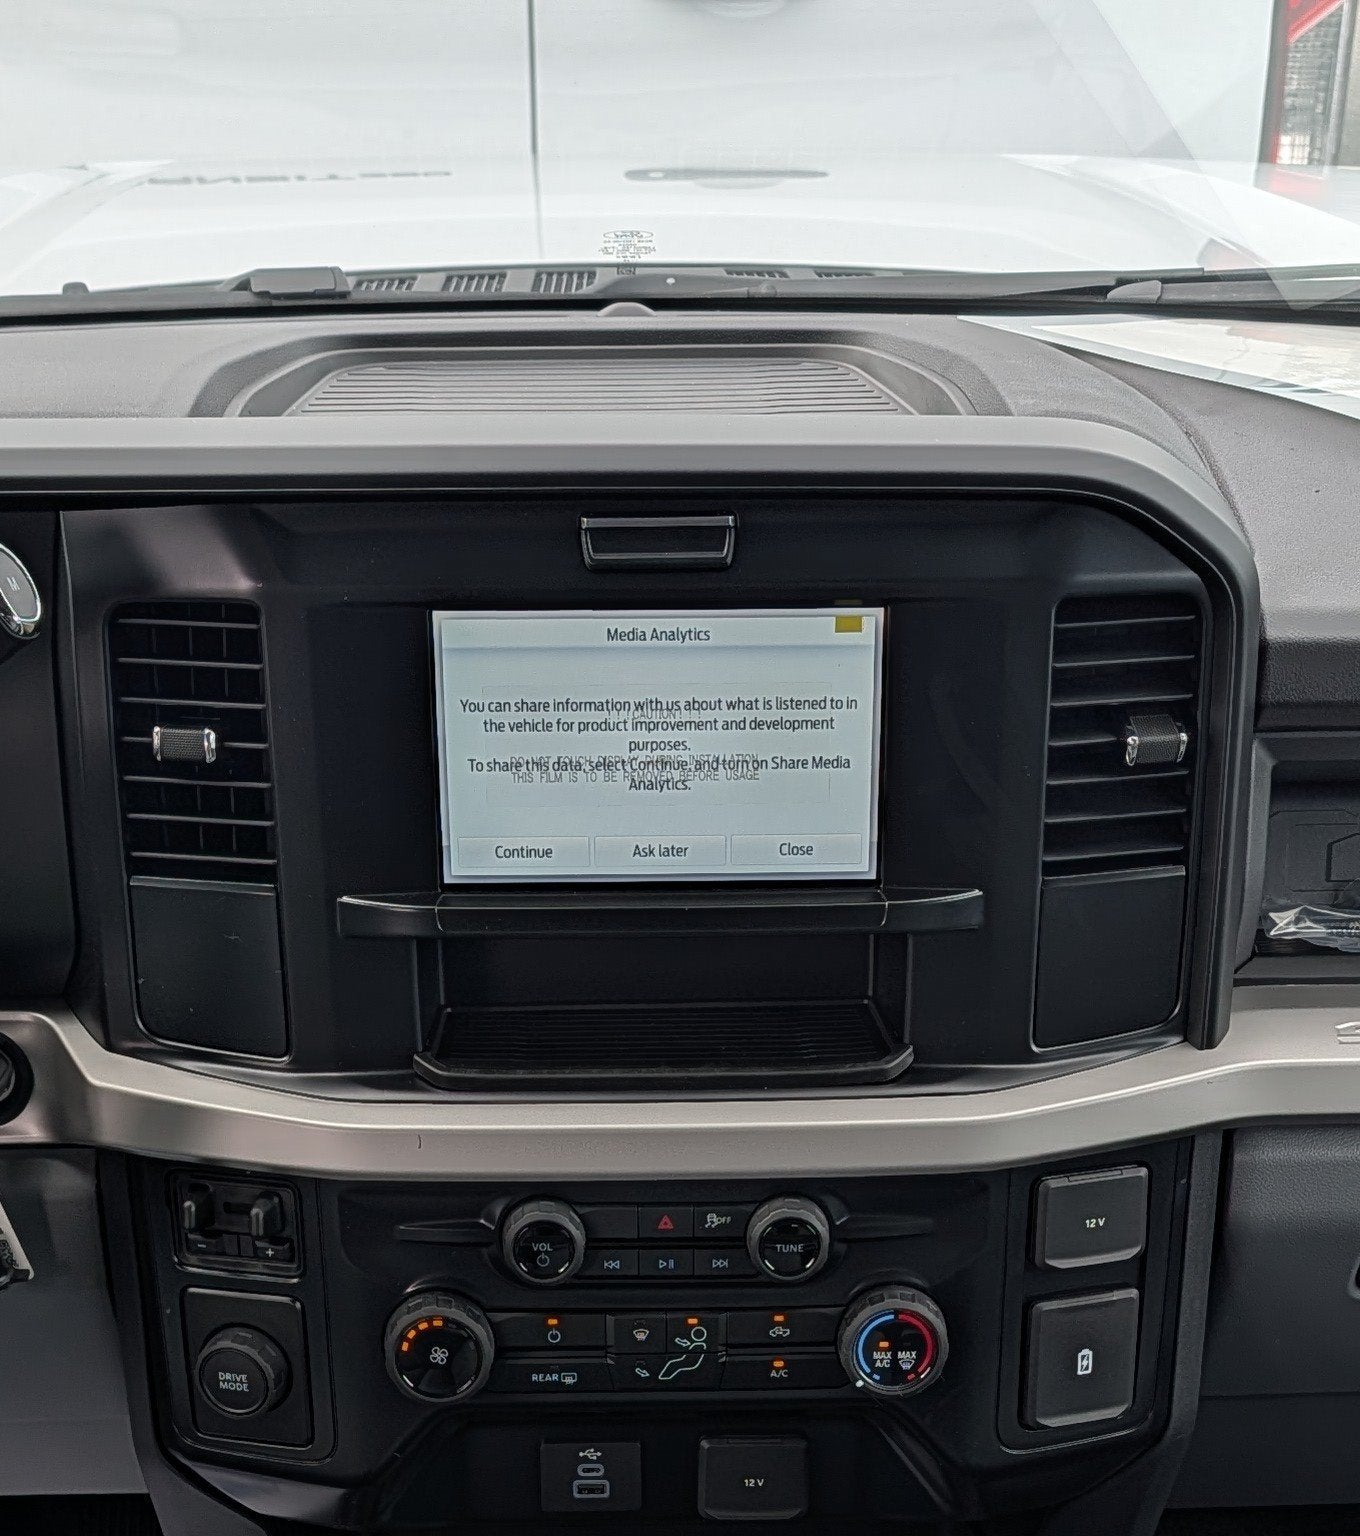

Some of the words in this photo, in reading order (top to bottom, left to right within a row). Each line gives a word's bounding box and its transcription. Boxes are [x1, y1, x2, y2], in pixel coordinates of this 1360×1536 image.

[606, 627, 646, 641] Media
[650, 627, 711, 643] Analytics
[460, 698, 485, 713] You
[487, 701, 511, 713] can
[513, 698, 550, 713] share
[553, 697, 631, 712] information
[633, 697, 665, 712] with
[666, 700, 681, 711] us
[683, 697, 723, 711] about
[726, 697, 760, 711] what
[763, 697, 773, 710] is
[775, 696, 827, 711] listened
[830, 697, 843, 710] to
[846, 696, 858, 710] in
[483, 718, 506, 733] the
[508, 718, 553, 733] vehicle
[556, 717, 575, 732] for
[578, 718, 629, 734] product
[631, 717, 719, 734] improvement
[722, 717, 746, 731] and
[749, 716, 835, 733] development
[628, 740, 691, 753] purposes.
[467, 758, 484, 773] To
[486, 758, 522, 773] share
[525, 757, 549, 772] this
[552, 758, 586, 774] data,
[589, 757, 627, 772] select
[630, 756, 692, 773] Continue,
[695, 756, 719, 771] and
[753, 759, 768, 770] on
[771, 755, 808, 770] Share
[812, 755, 851, 770] Media
[511, 771, 534, 784] THIS
[539, 771, 563, 783] FILM
[569, 771, 578, 783] IS
[585, 771, 597, 783] TO
[604, 771, 617, 783] BE
[679, 770, 720, 782] BEFORE
[726, 770, 760, 781] USAGE
[628, 777, 692, 793] Analytics.
[494, 845, 553, 859] Continue
[632, 844, 656, 858] Ask
[658, 843, 689, 857] later
[779, 843, 814, 856] Close
[1085, 1218, 1097, 1228] 12
[1097, 1217, 1106, 1227] V
[531, 1243, 553, 1252] VOL
[775, 1243, 805, 1253] TUNE
[873, 1351, 892, 1360] MAX
[897, 1351, 917, 1359] MAX
[875, 1359, 891, 1368] A/C
[218, 1372, 248, 1382] DRIVE
[531, 1373, 559, 1382] REAR
[770, 1369, 789, 1378] A/C
[220, 1381, 249, 1392] MODE
[744, 1478, 756, 1487] 12
[755, 1478, 765, 1487] V
